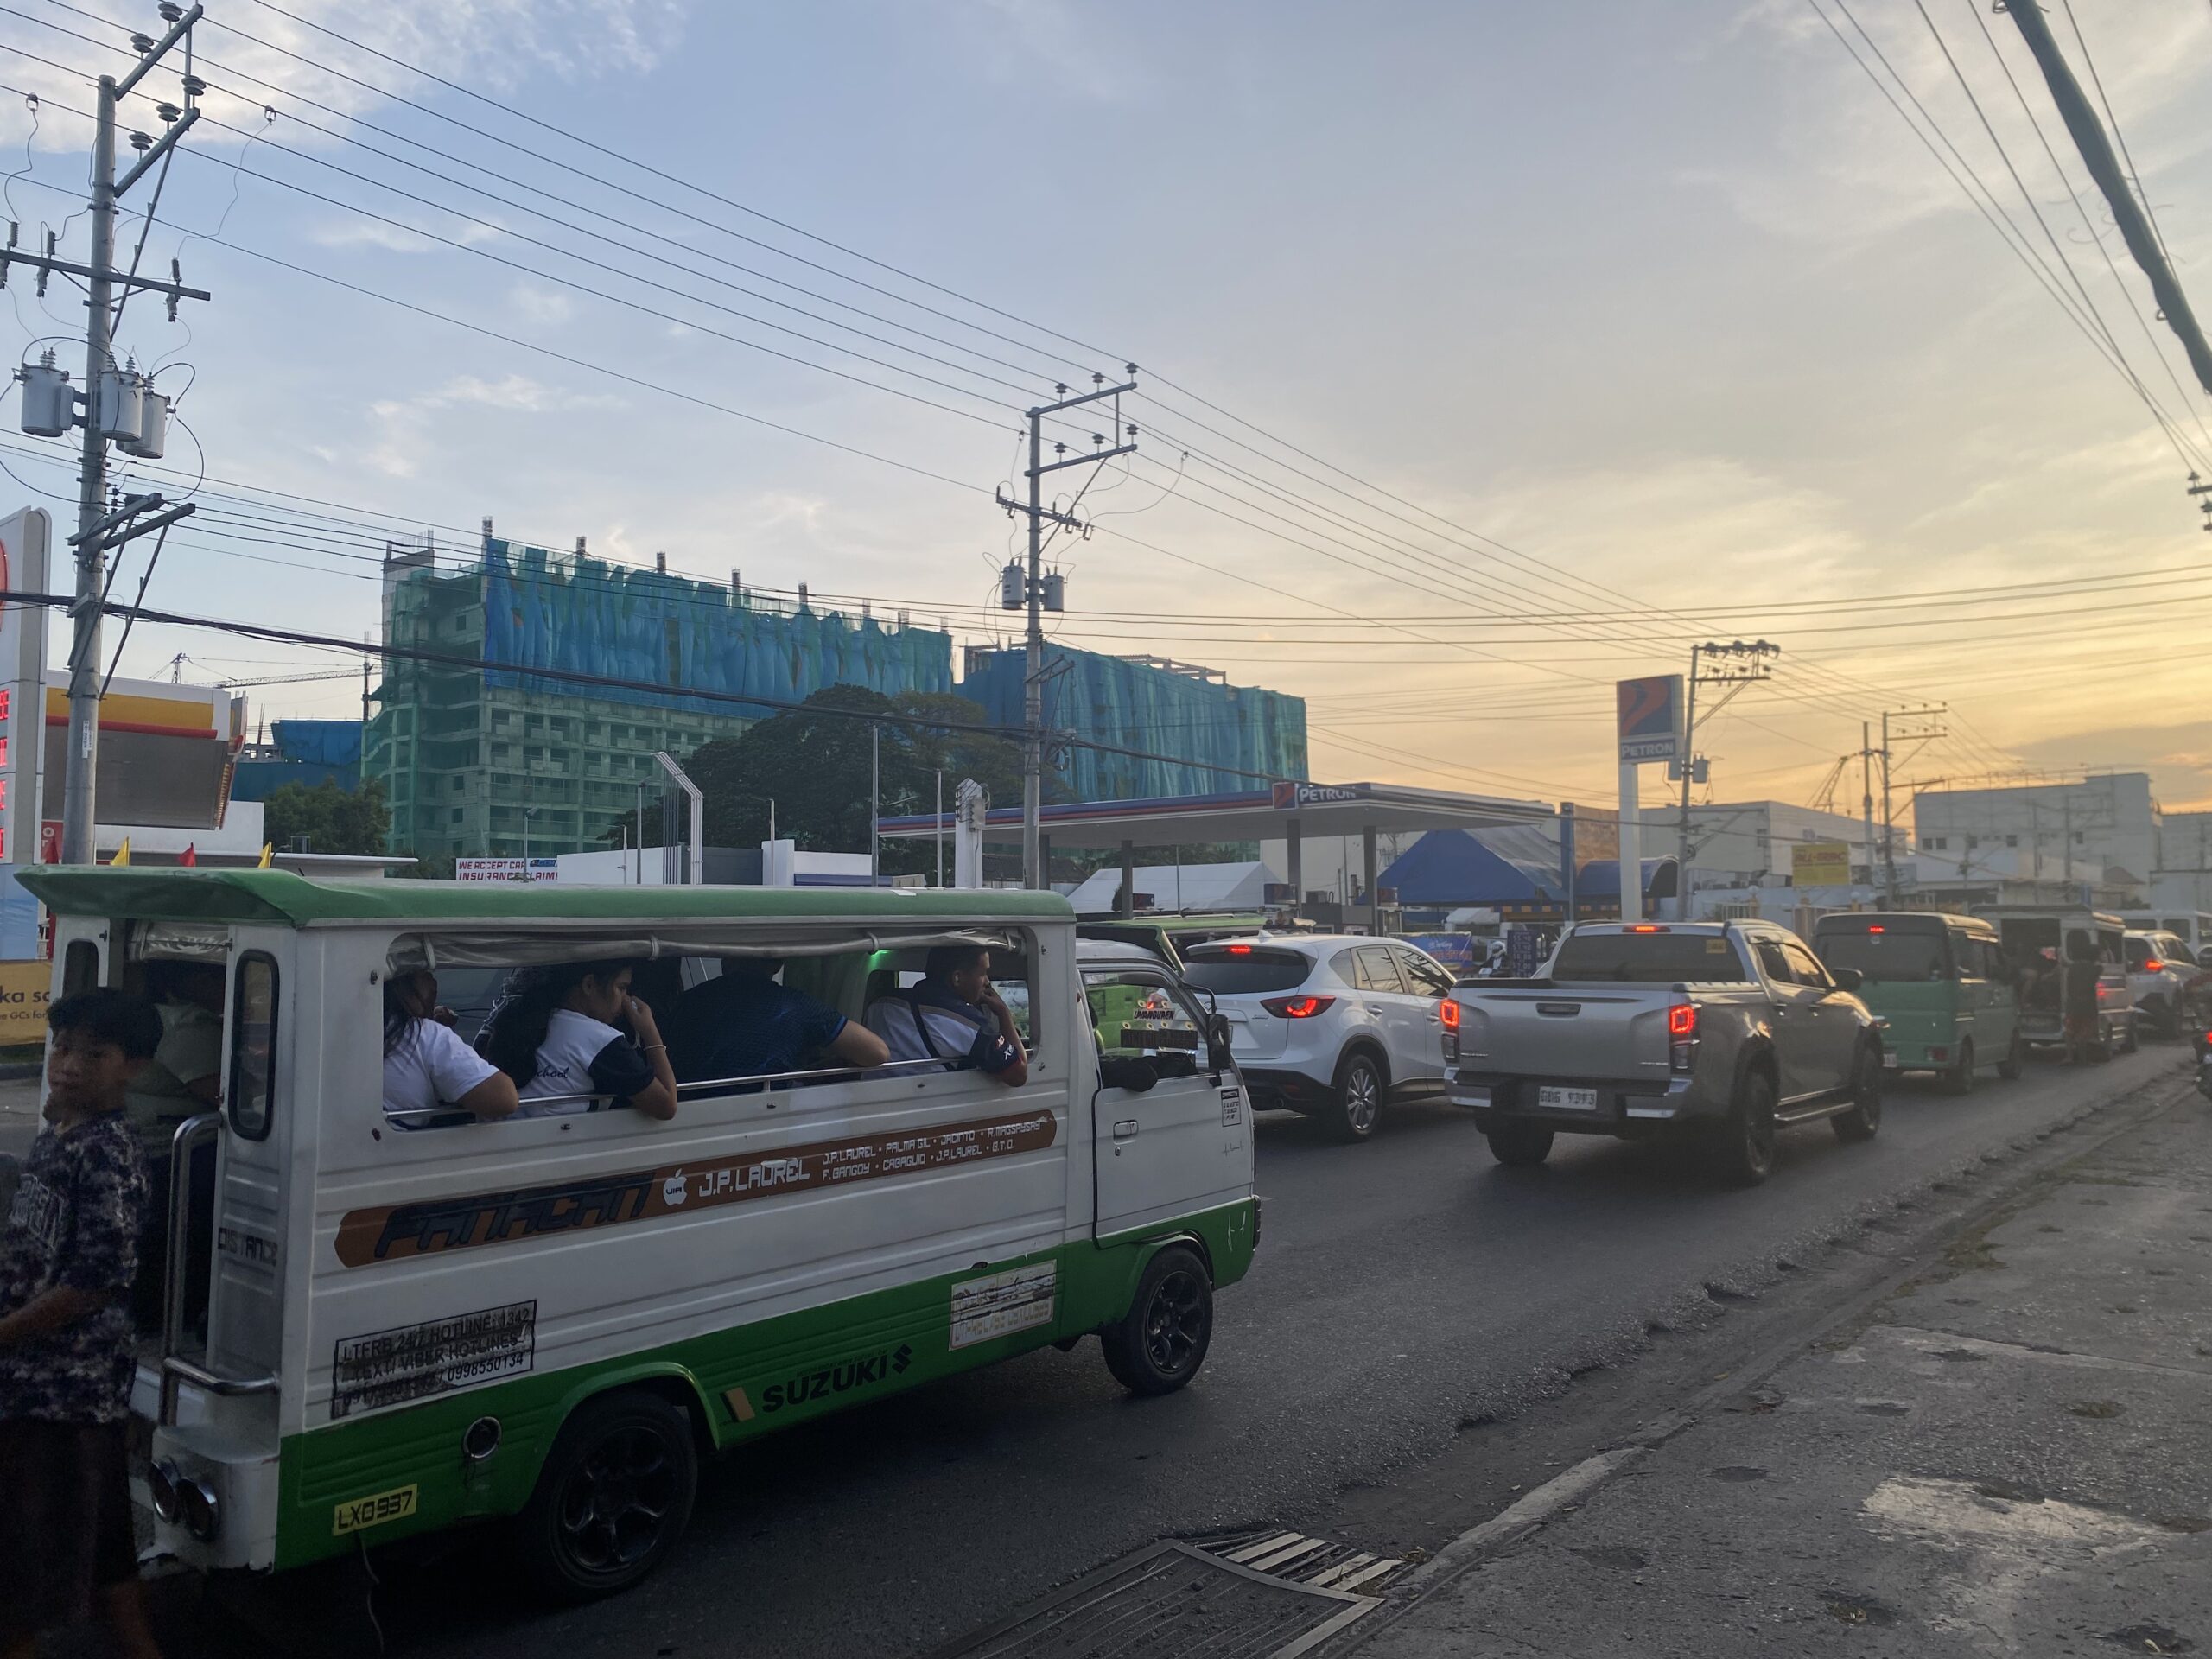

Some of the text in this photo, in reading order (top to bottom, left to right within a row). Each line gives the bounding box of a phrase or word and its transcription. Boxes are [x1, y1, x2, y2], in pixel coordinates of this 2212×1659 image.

[1621, 742, 1675, 758] PETRON
[536, 1064, 569, 1078] chool
[886, 1139, 916, 1154] PALMA
[917, 1137, 931, 1149] GIL
[940, 1130, 976, 1146] JACINTO
[344, 1338, 392, 1361] LTFRB
[761, 1354, 888, 1413] SUZUKI
